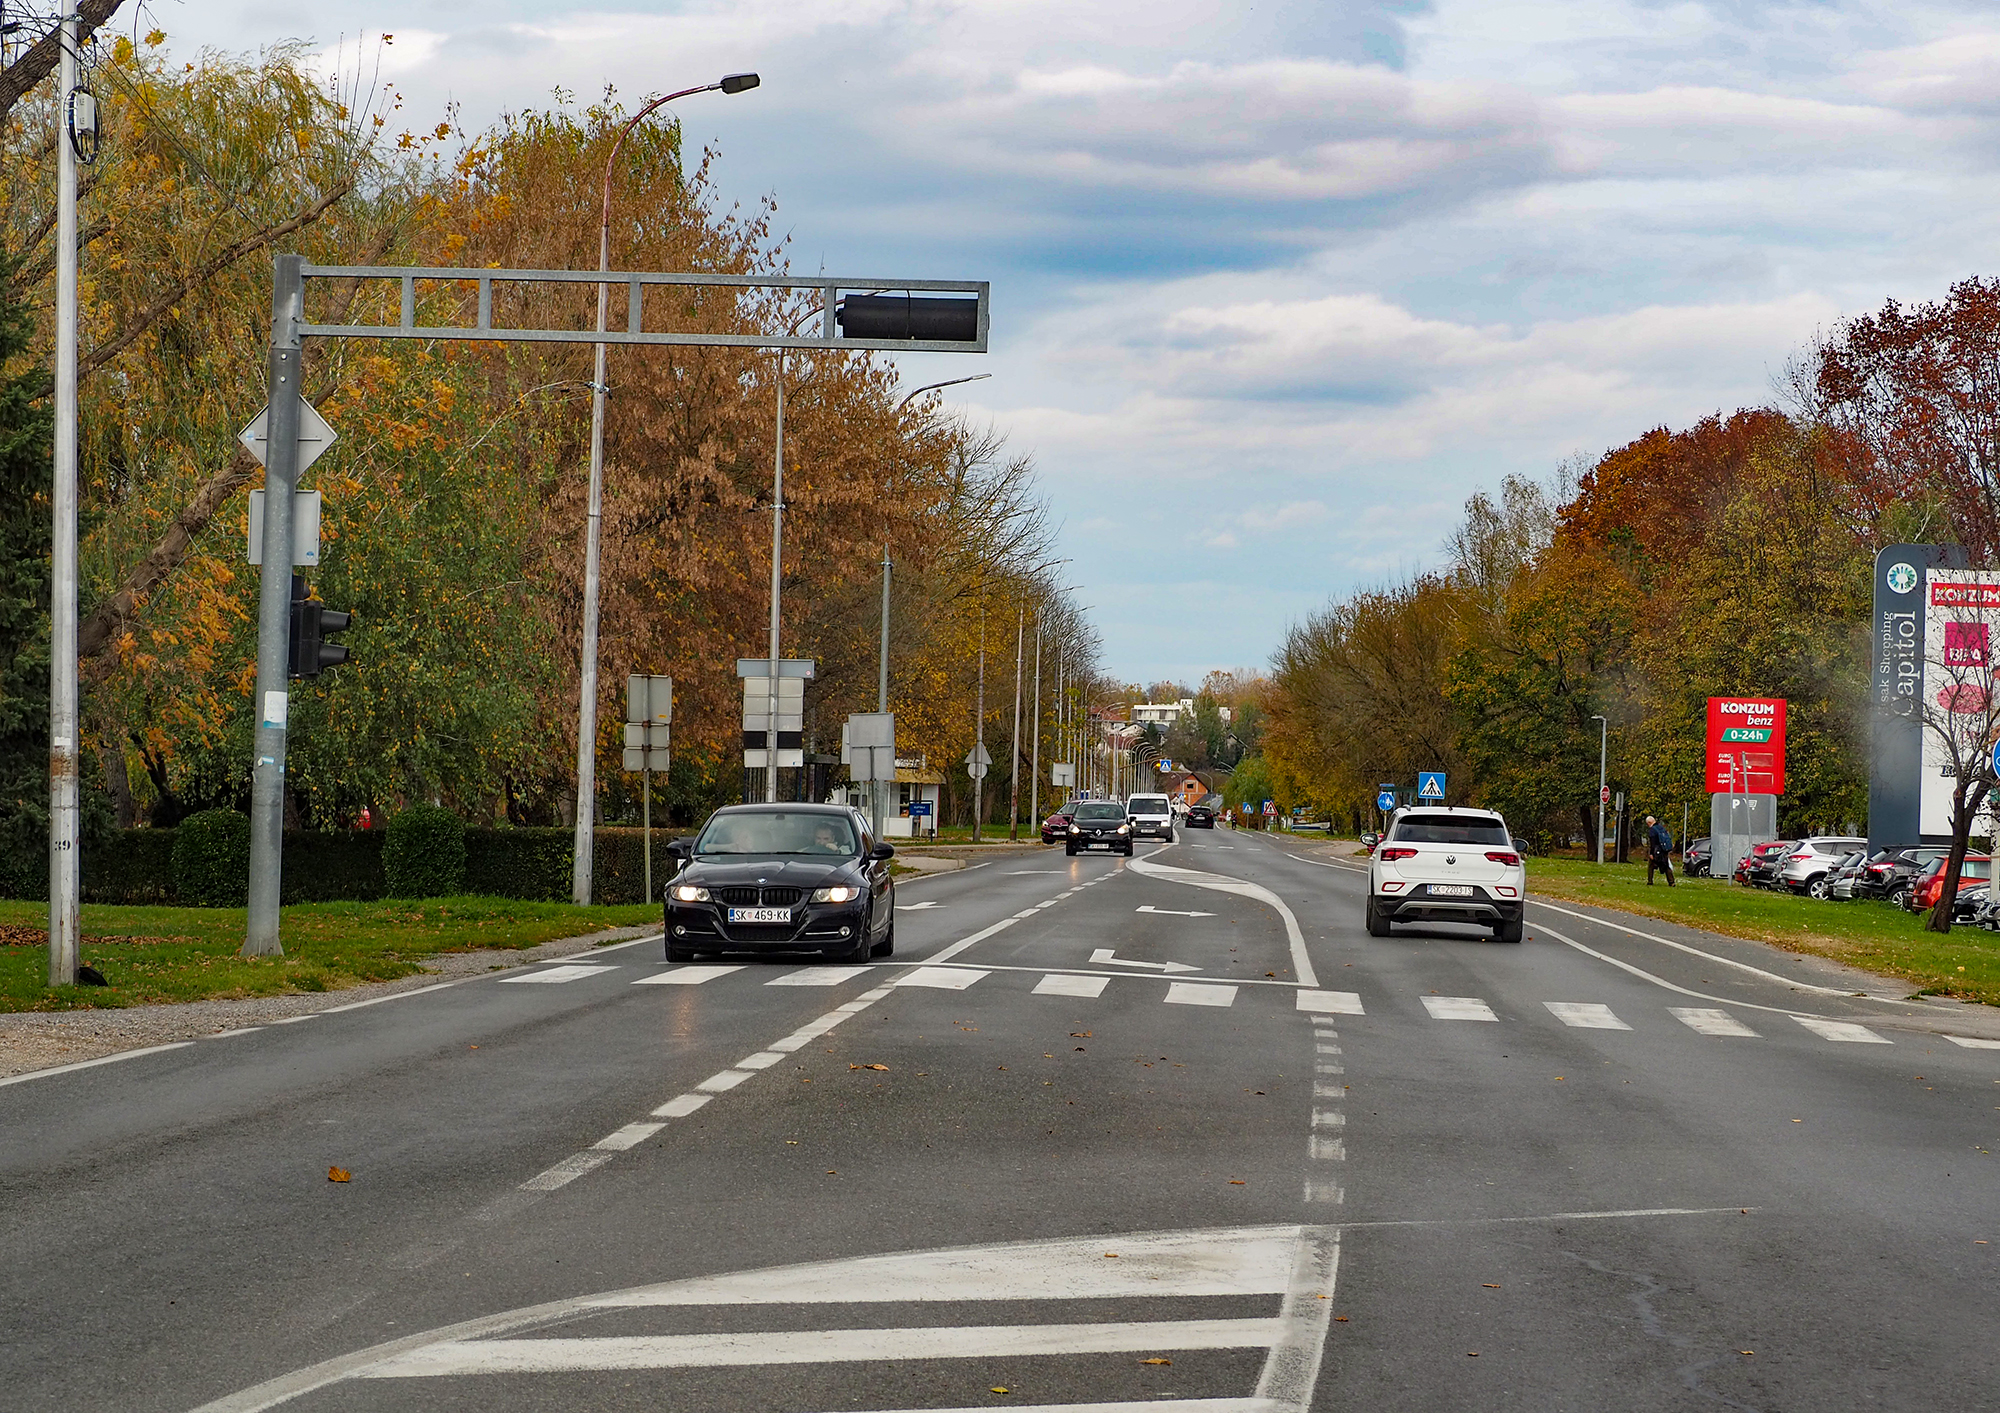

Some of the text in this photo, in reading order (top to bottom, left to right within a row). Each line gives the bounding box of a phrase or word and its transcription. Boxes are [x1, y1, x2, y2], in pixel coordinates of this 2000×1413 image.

[1934, 588, 2000, 603] KONZUM
[1880, 611, 1893, 674] Shopping
[1720, 702, 1774, 714] KONZUM
[1746, 714, 1774, 726] benz
[1730, 730, 1764, 740] 0-24h
[54, 840, 71, 851] 39
[1432, 885, 1440, 894] SK
[735, 910, 789, 920] SK 469-KK
